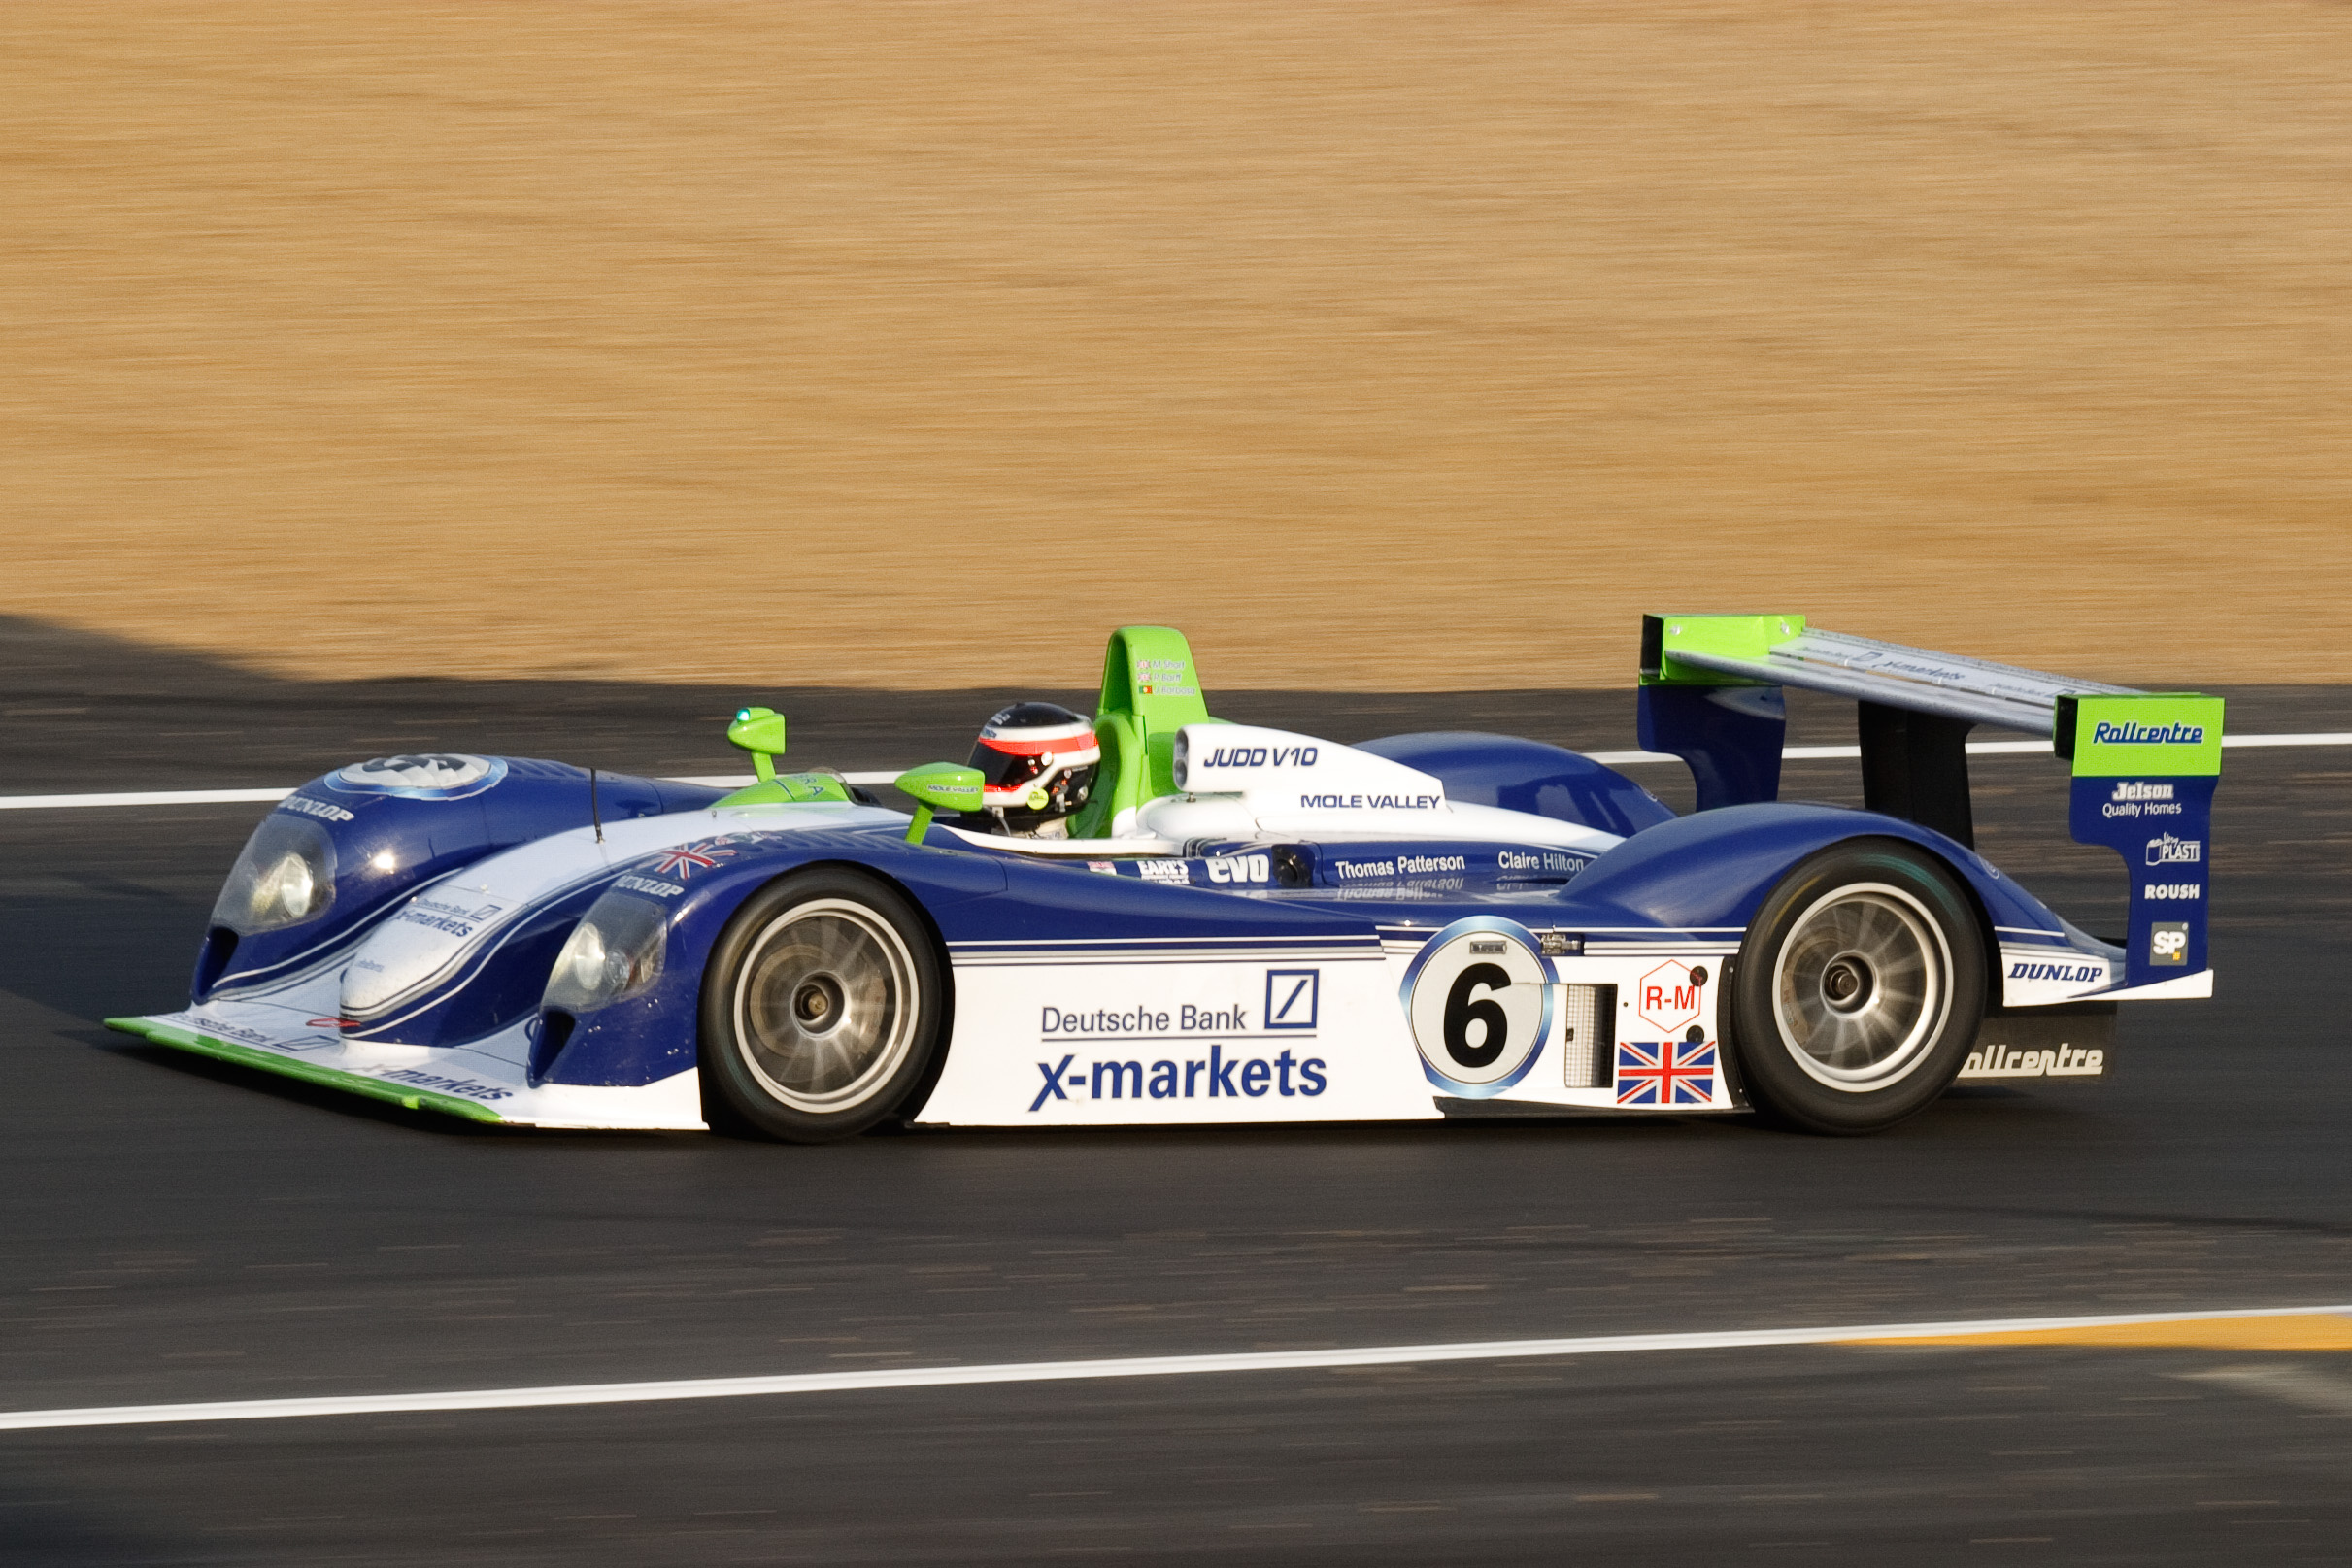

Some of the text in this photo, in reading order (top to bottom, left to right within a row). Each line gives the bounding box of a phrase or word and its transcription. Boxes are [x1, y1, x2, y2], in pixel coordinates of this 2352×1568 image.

[2093, 721, 2203, 744] Rollcentre
[1204, 747, 1318, 767] JUDD V10
[1300, 795, 1441, 809] MOLE VALLEY
[2111, 782, 2174, 801] Jelson
[278, 795, 355, 822] DUNLOP
[2102, 803, 2183, 819] Quality Homes
[1498, 851, 1585, 873] Claire Hilton
[2162, 844, 2197, 860] PLAST
[1205, 854, 1270, 884] evo
[1335, 854, 1466, 880] Thomas Patterson
[612, 875, 685, 898] DUNLOP
[2144, 884, 2201, 900] ROUSH
[2008, 962, 2103, 983] DUNLOP
[1646, 985, 1696, 1011] R-M
[1041, 1003, 1247, 1034] Deutsche Bank
[1443, 962, 1512, 1069] 6
[1956, 1042, 2104, 1079] ollcentre
[1027, 1044, 1327, 1112] x-markets
